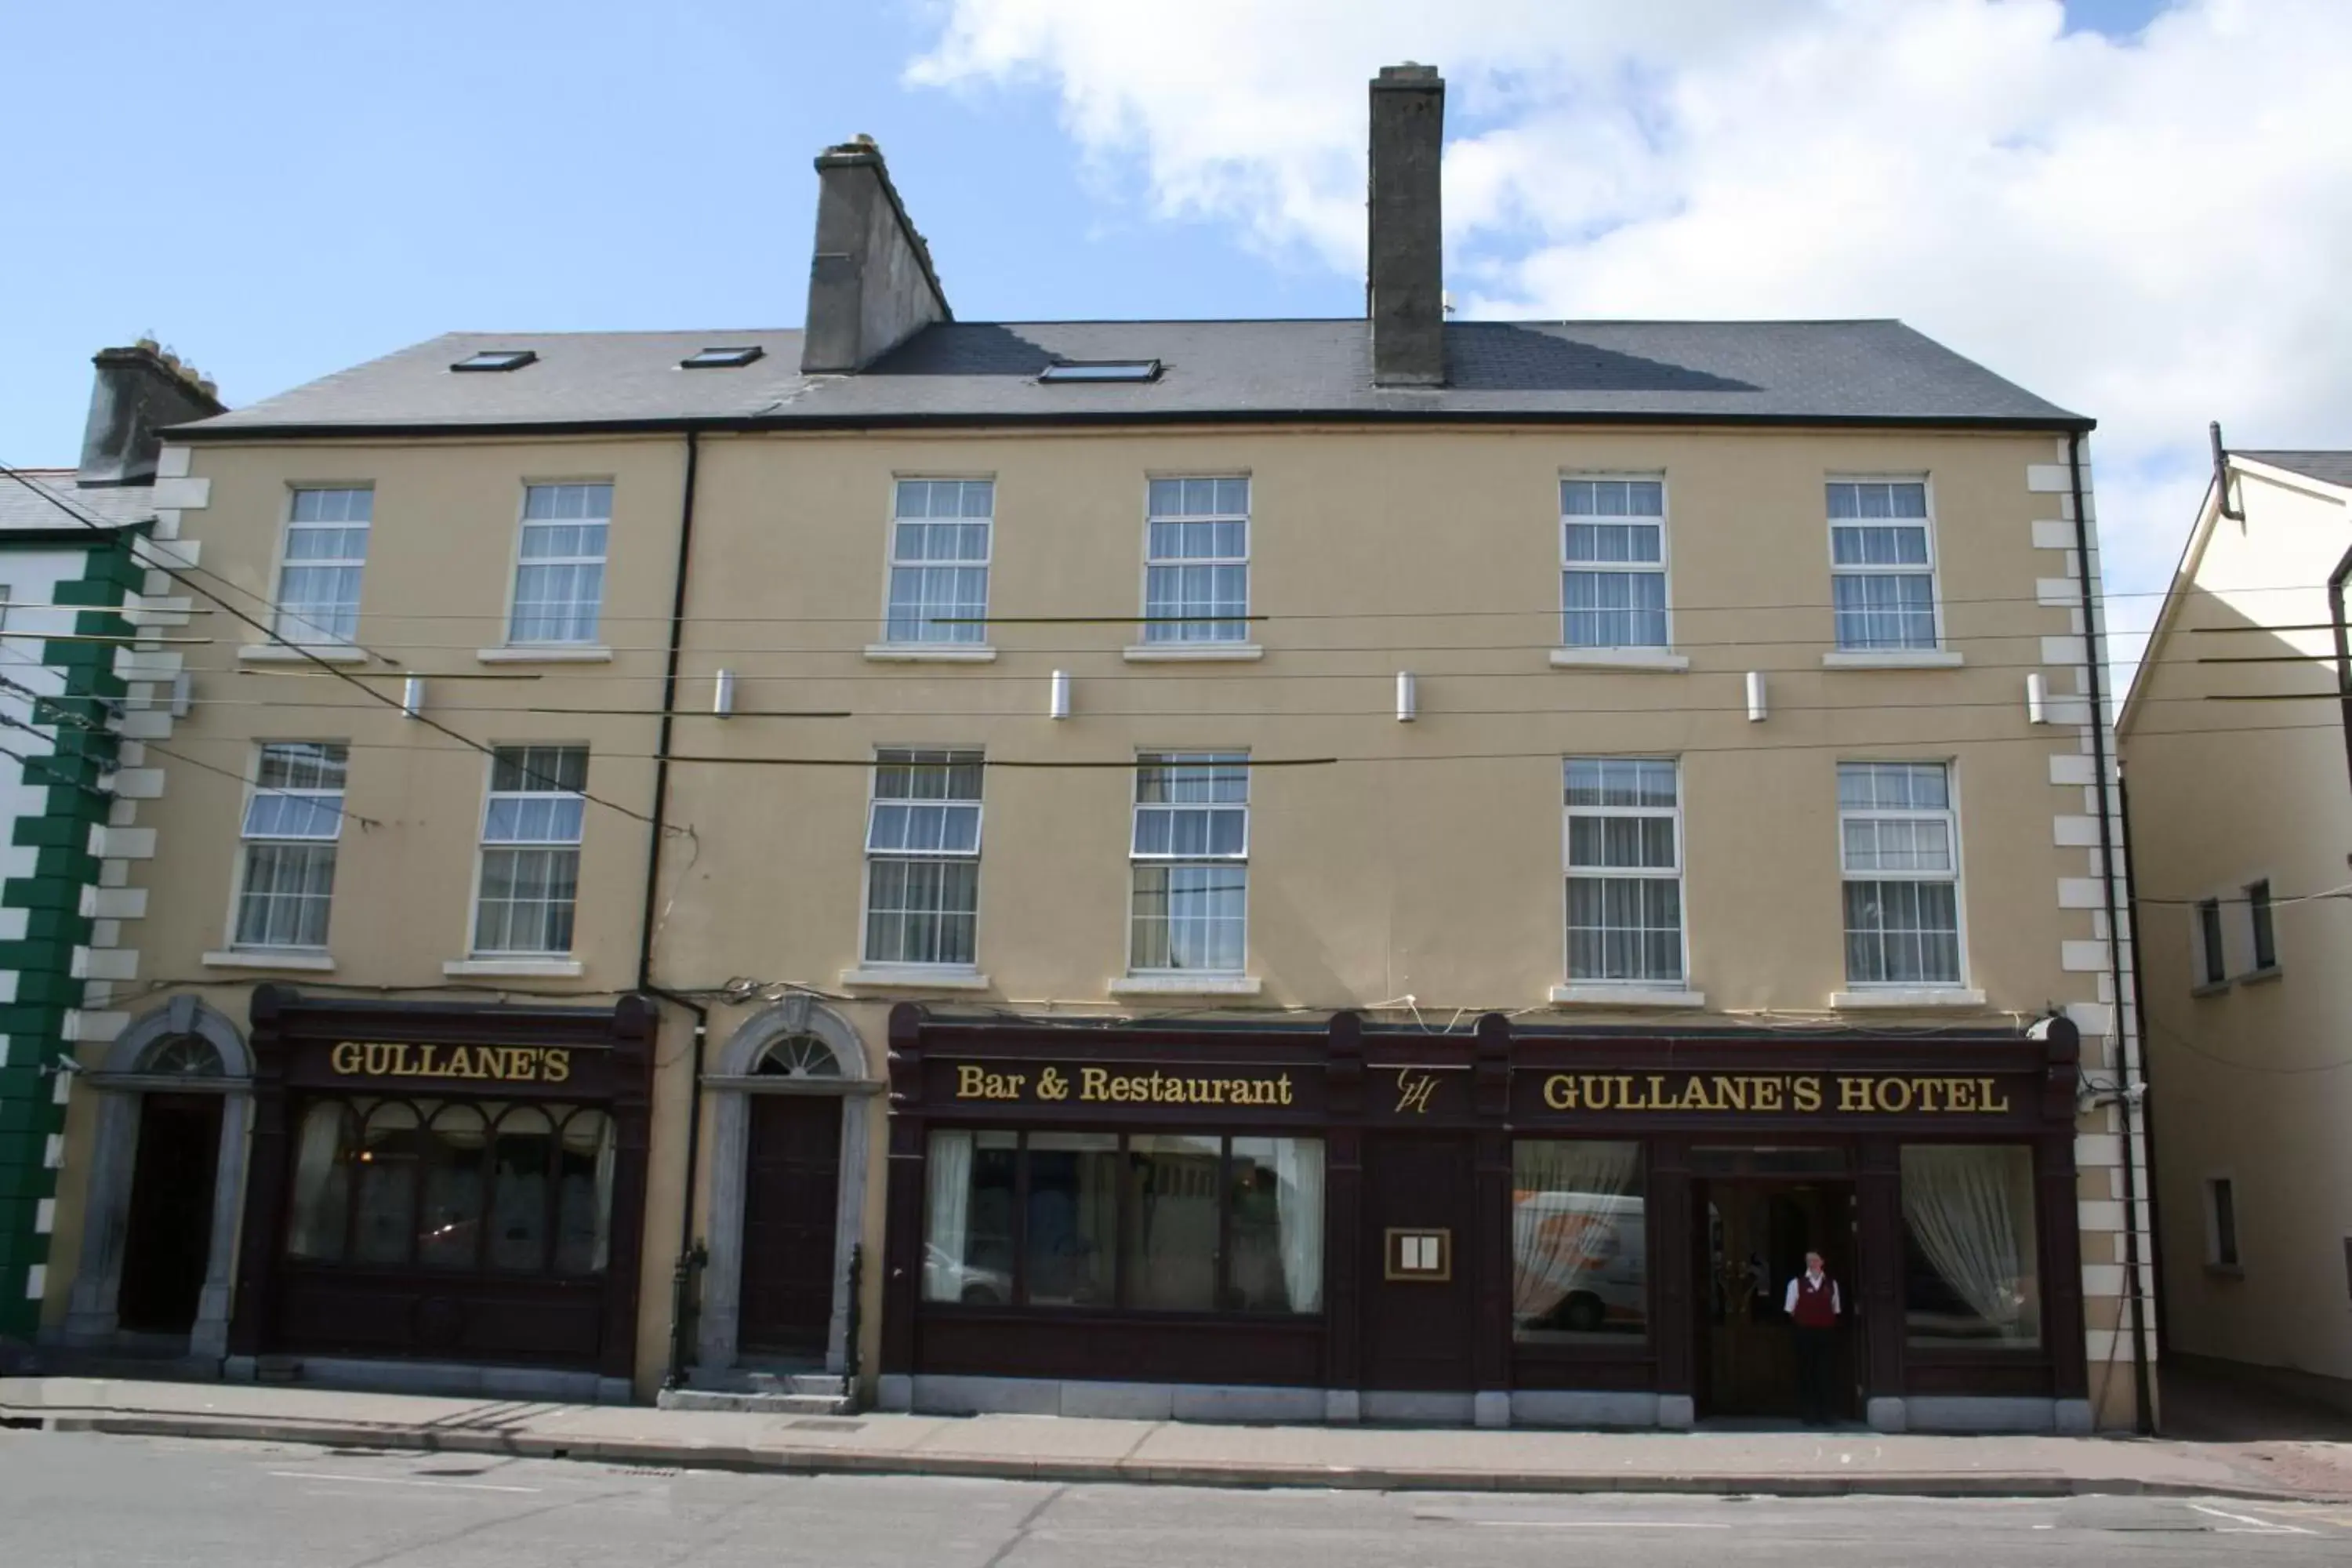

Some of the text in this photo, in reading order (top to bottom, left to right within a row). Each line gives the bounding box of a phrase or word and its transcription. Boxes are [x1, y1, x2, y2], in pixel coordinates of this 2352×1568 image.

[331, 1041, 571, 1083] GULLANE'S
[956, 1065, 1294, 1105] Bar & Restaurant
[1543, 1074, 2009, 1112] GULLANE'S HOTEL
